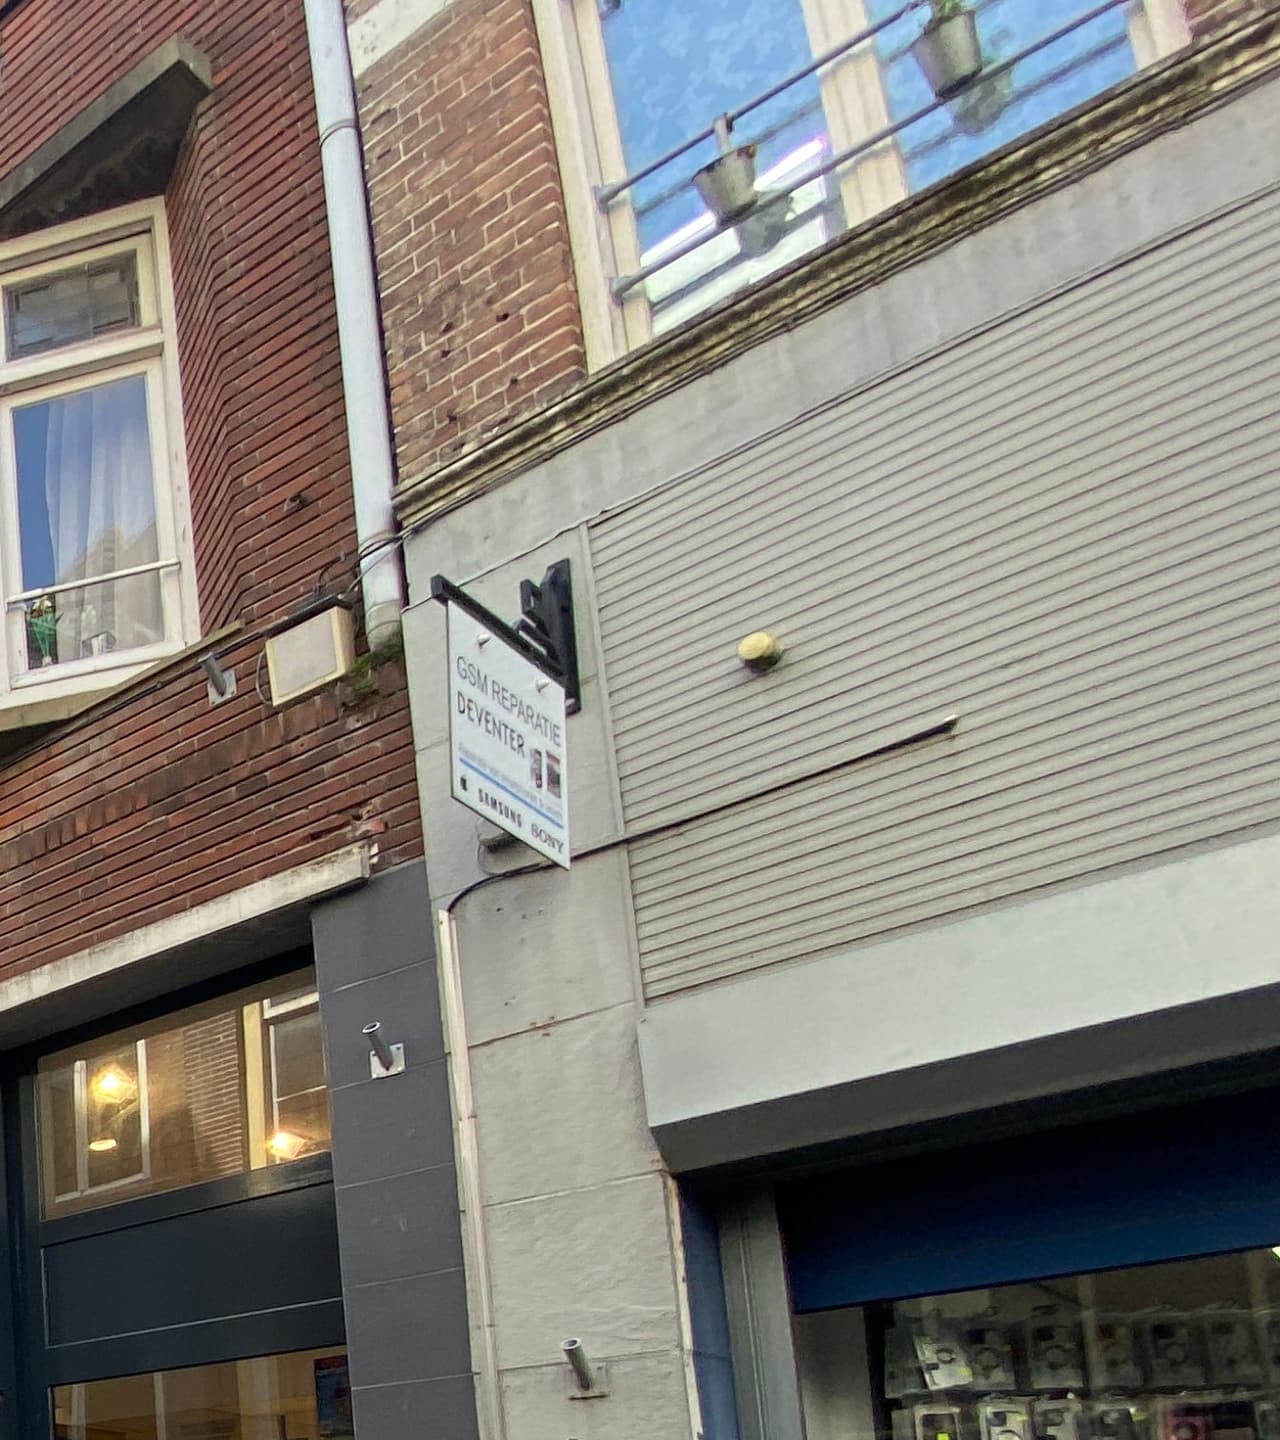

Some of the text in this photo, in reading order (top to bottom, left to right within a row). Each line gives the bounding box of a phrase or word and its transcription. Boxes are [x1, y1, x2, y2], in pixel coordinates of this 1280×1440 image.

[457, 656, 562, 747] GSM REPARATIE
[457, 691, 525, 757] DEVENTER
[478, 788, 565, 855] SAMSUNG SONY
